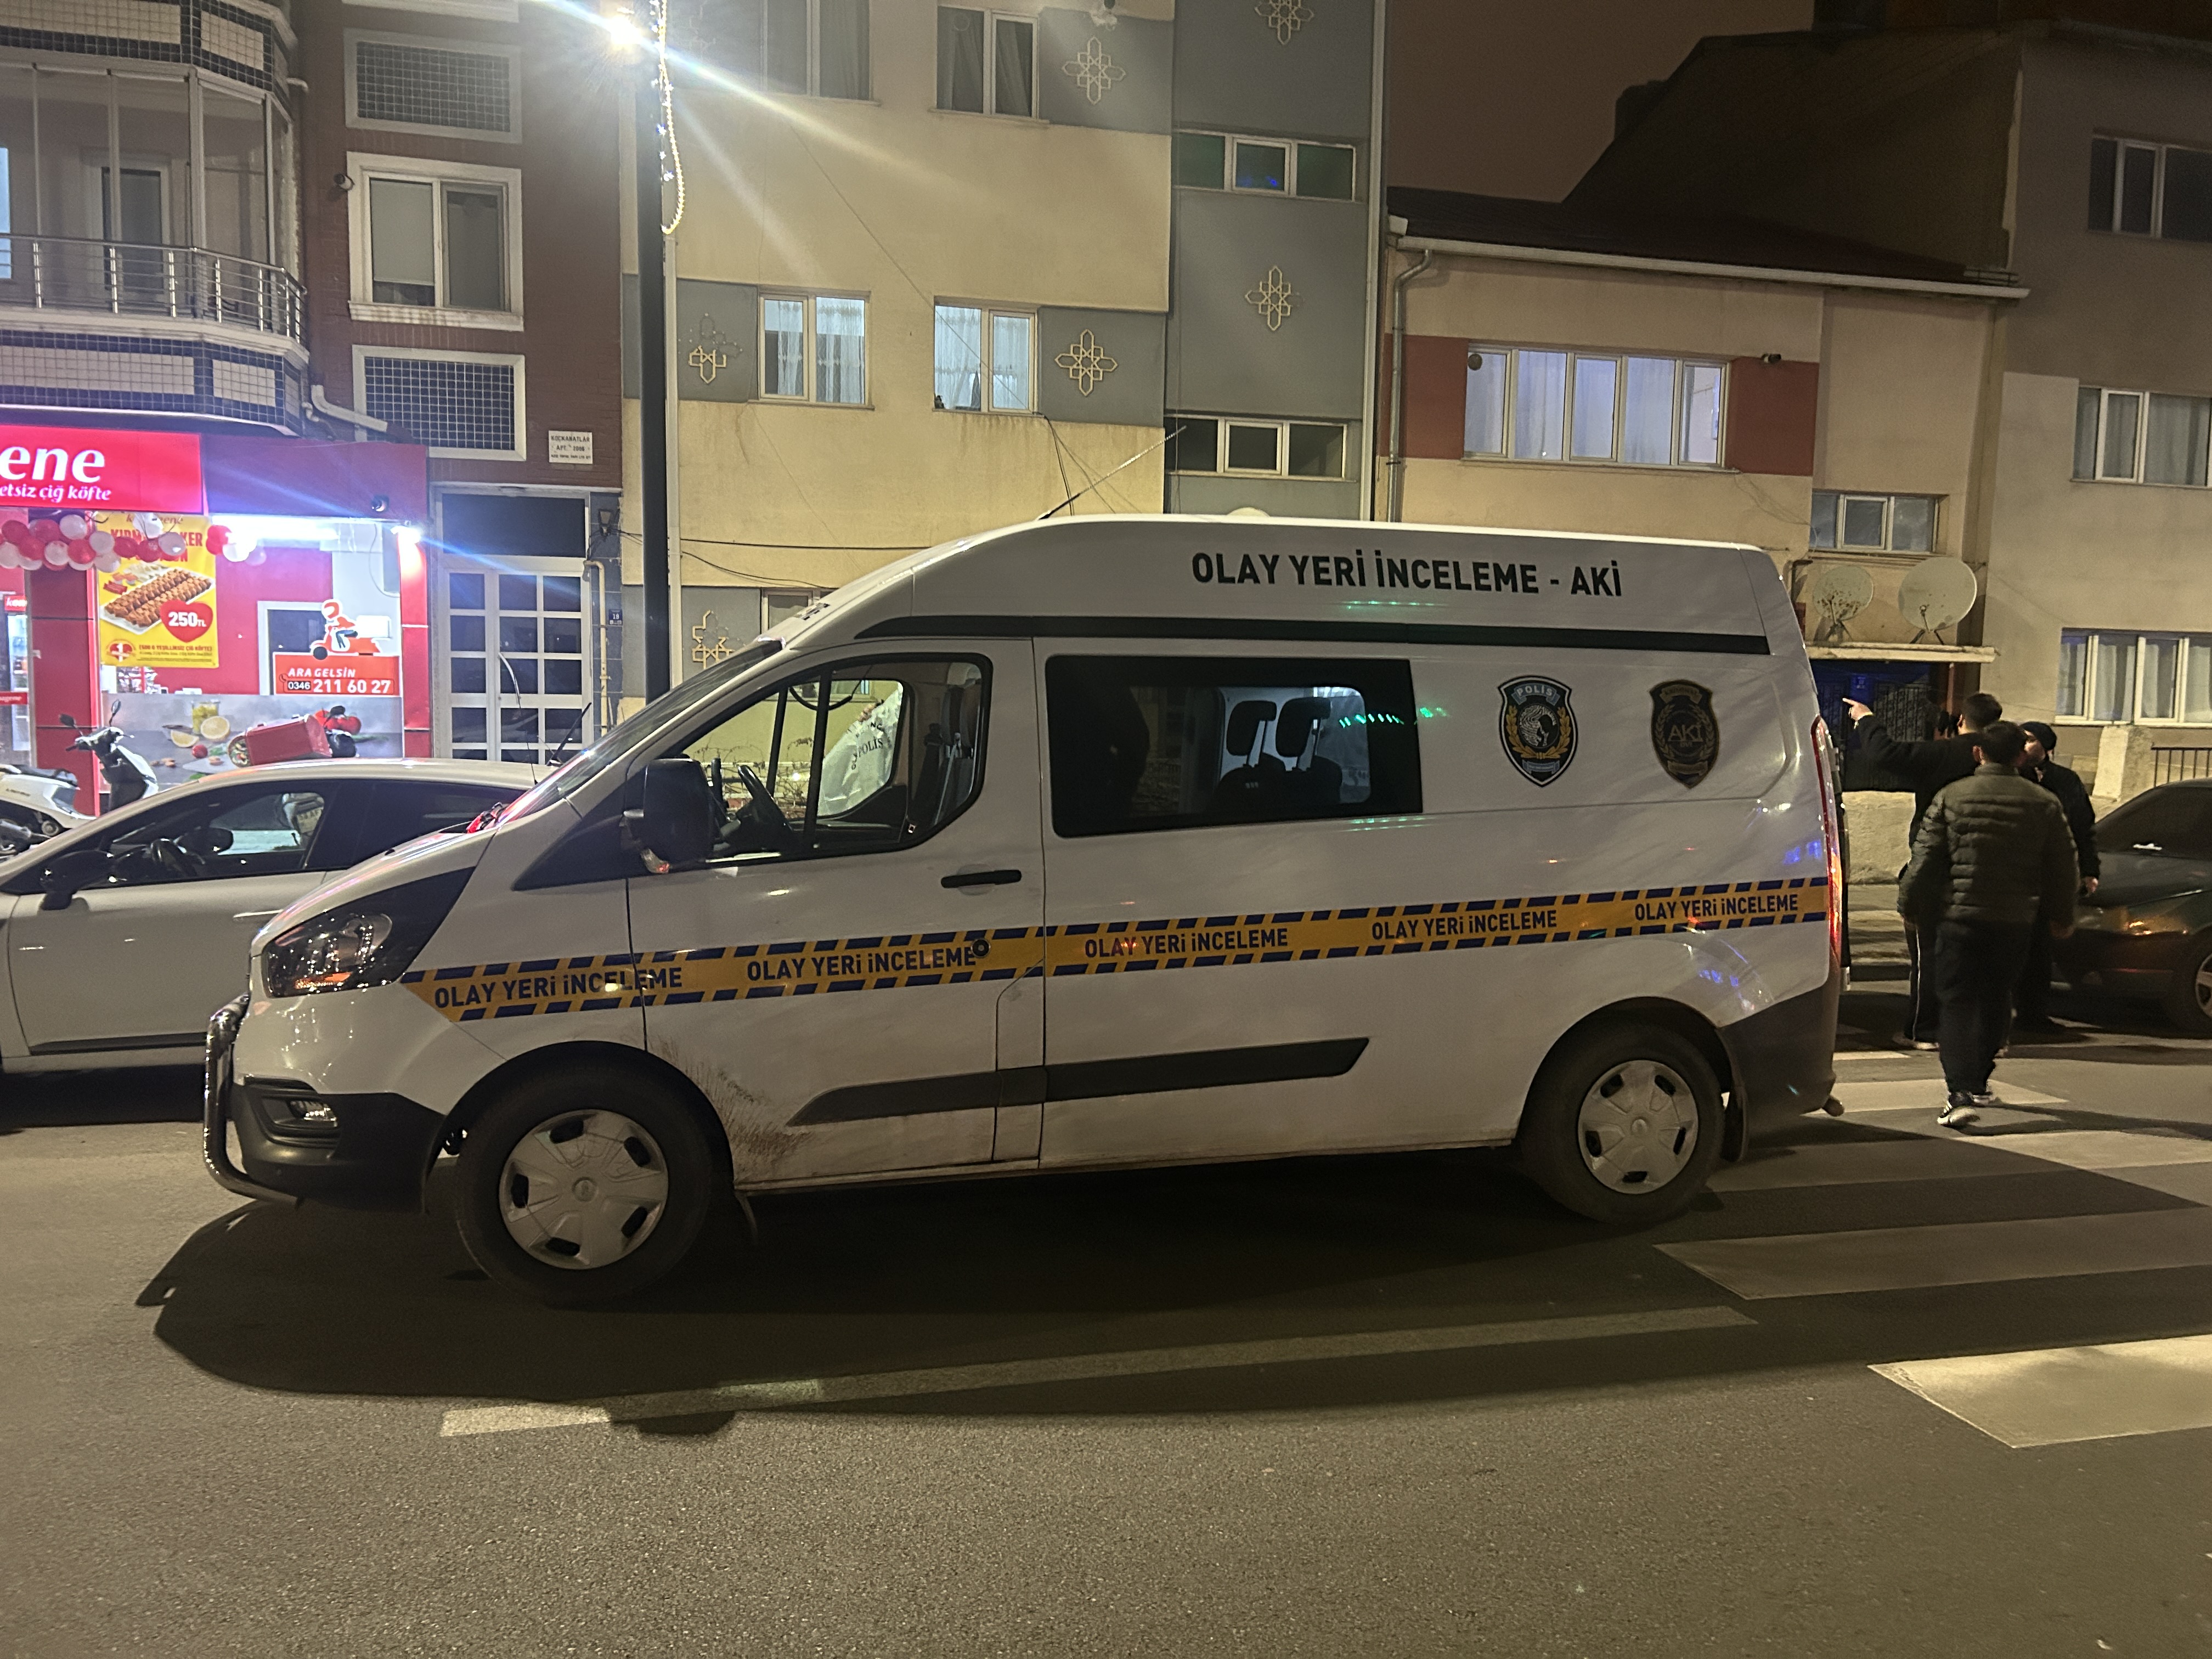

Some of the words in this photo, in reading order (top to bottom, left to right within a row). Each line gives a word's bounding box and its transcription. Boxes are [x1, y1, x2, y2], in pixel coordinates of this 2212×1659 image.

[0, 446, 105, 483] ene
[39, 484, 64, 503] çiğ
[67, 485, 112, 501] köfte
[1192, 553, 1279, 584] OLAY
[1288, 549, 1367, 586] YERİ
[1375, 550, 1539, 594] İNCELEME
[1571, 560, 1622, 597] AKİ
[288, 668, 312, 678] ARA
[314, 667, 356, 678] GELSİN
[288, 681, 311, 690] 0346
[313, 679, 341, 693] 211
[347, 679, 367, 693] 60
[371, 680, 391, 694] 27
[1635, 901, 1677, 921] OLAY
[1372, 919, 1419, 940] OLAY
[1085, 937, 1136, 958] OLAY
[747, 958, 805, 981] OLAY
[435, 981, 495, 1008] OLAY
